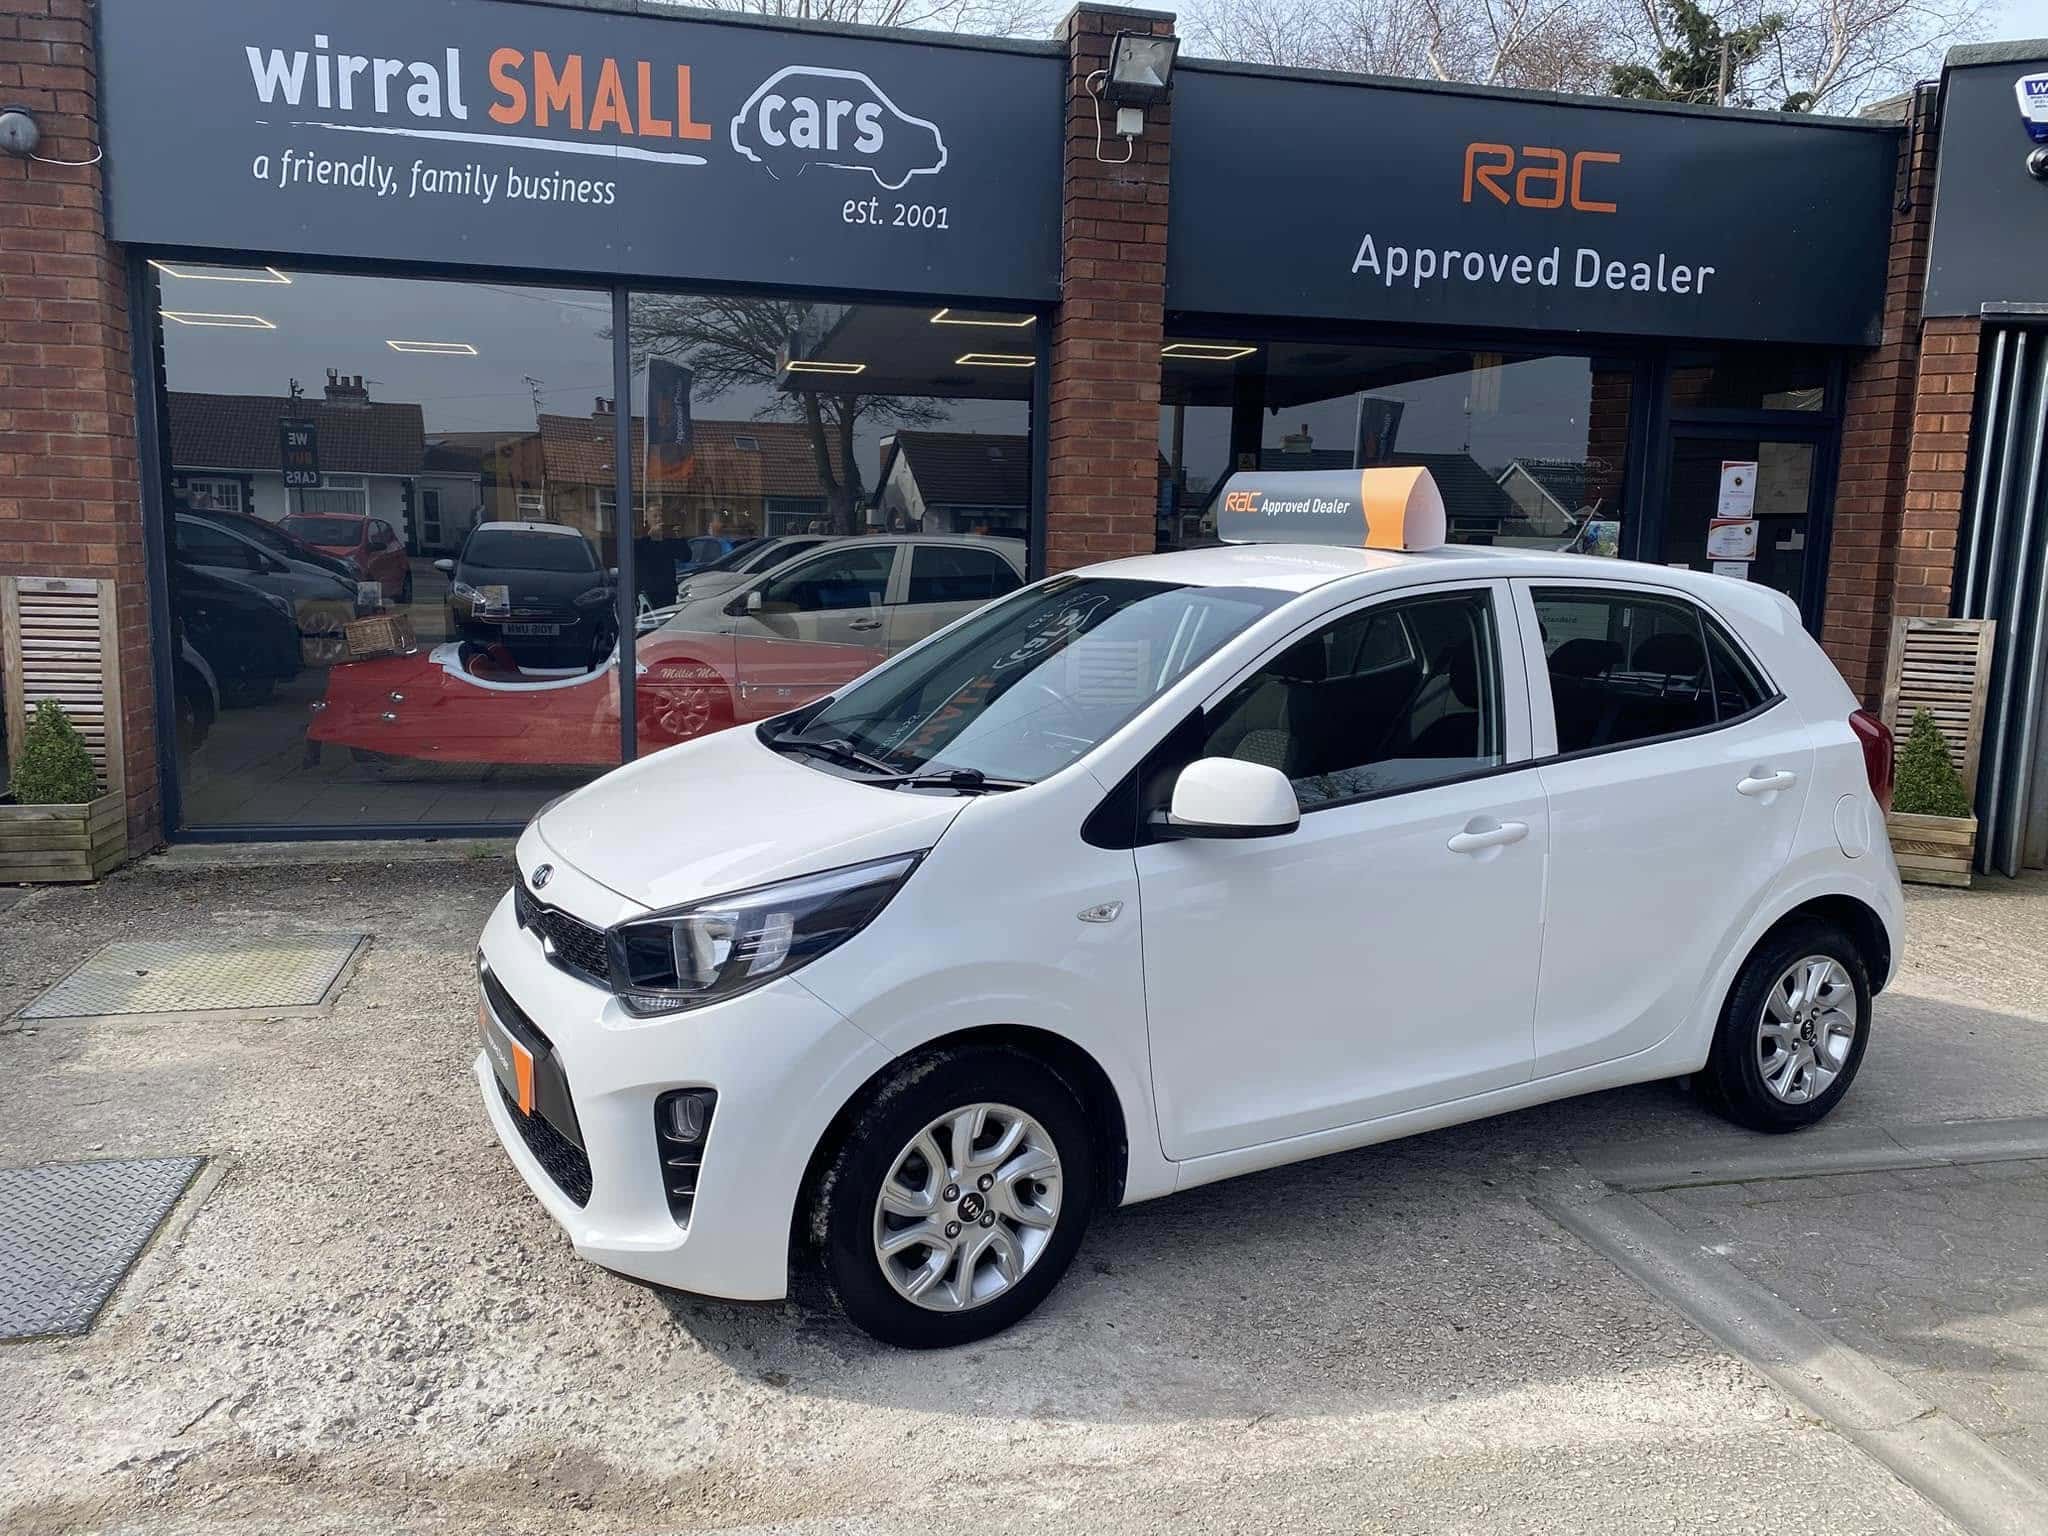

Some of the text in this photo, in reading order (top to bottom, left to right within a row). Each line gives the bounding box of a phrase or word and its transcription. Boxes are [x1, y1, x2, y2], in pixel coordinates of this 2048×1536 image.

[245, 34, 885, 153] wirral SMALL cars
[252, 151, 616, 205] a friendly, family business
[842, 199, 949, 230] est. 2001
[1351, 234, 1715, 295] Approved Dealer
[1261, 498, 1311, 517] Approved
[1312, 498, 1350, 514] Dealer
